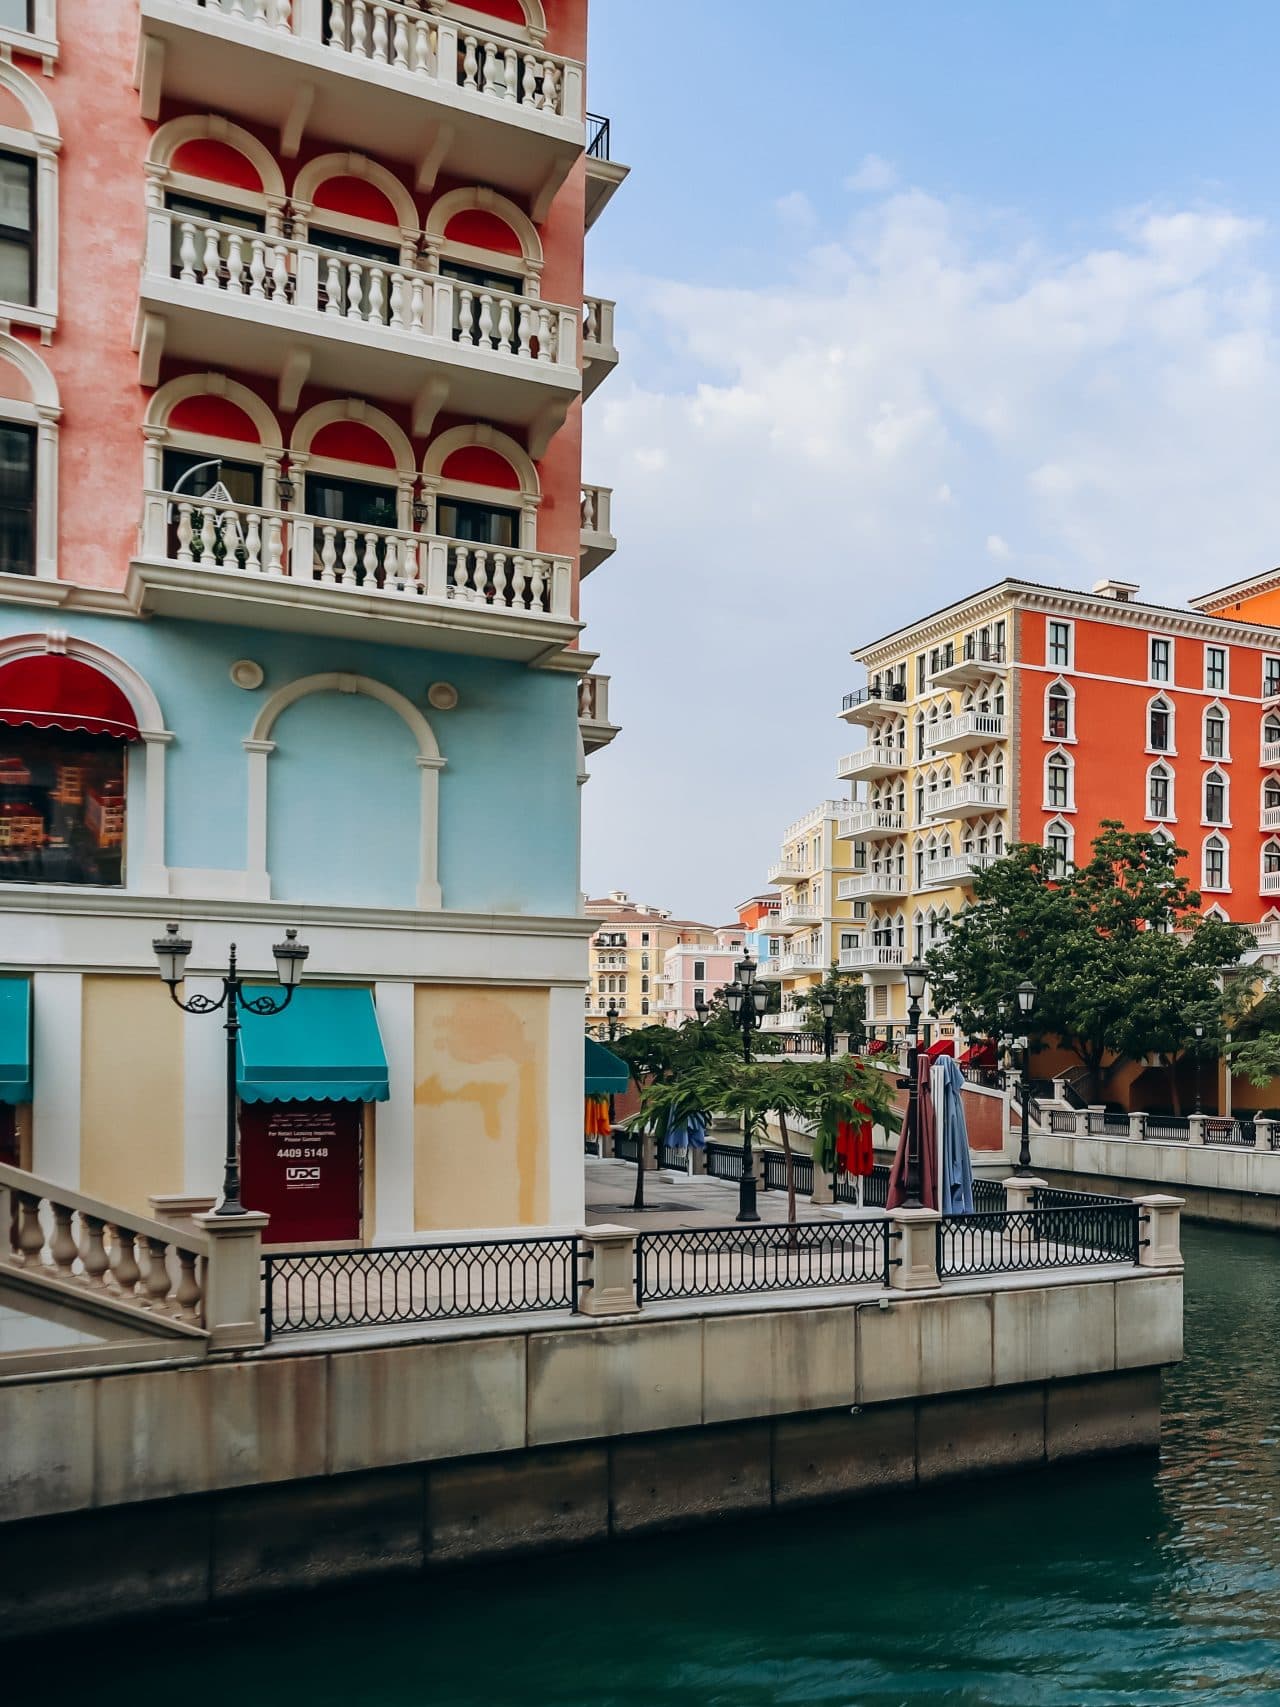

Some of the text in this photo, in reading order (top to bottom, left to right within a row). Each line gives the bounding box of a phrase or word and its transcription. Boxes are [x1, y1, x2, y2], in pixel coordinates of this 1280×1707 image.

[276, 1147, 328, 1158] 4409 5148
[287, 1167, 320, 1179] UDC
